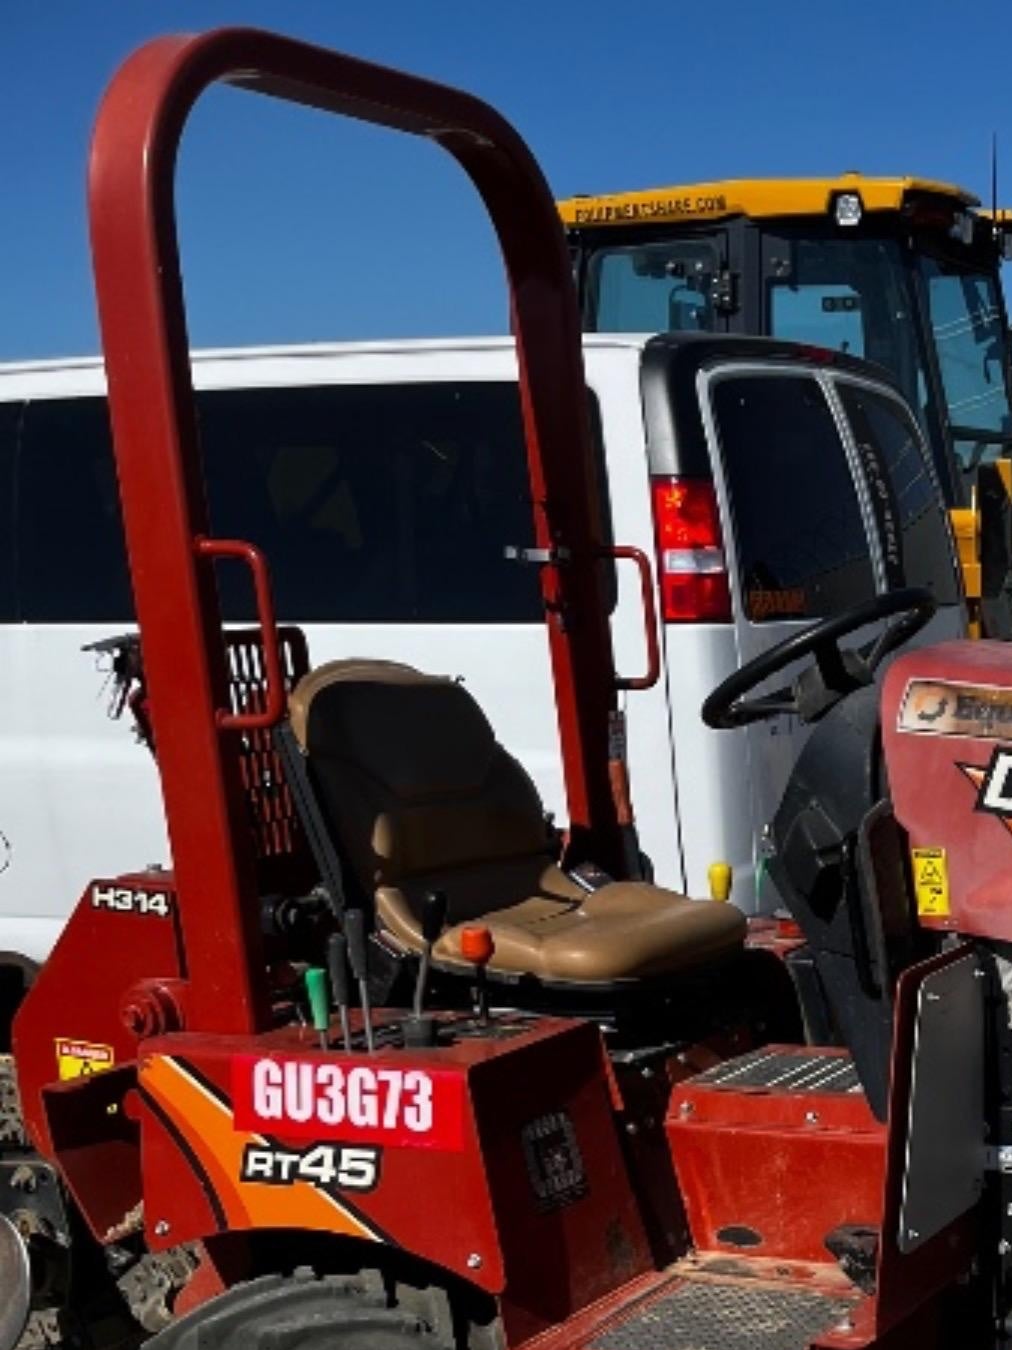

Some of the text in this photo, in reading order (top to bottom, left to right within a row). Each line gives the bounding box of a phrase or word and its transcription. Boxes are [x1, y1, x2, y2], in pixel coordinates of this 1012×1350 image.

[92, 886, 169, 916] H314
[253, 1057, 434, 1133] GU3G73
[244, 1145, 378, 1188] RT45
